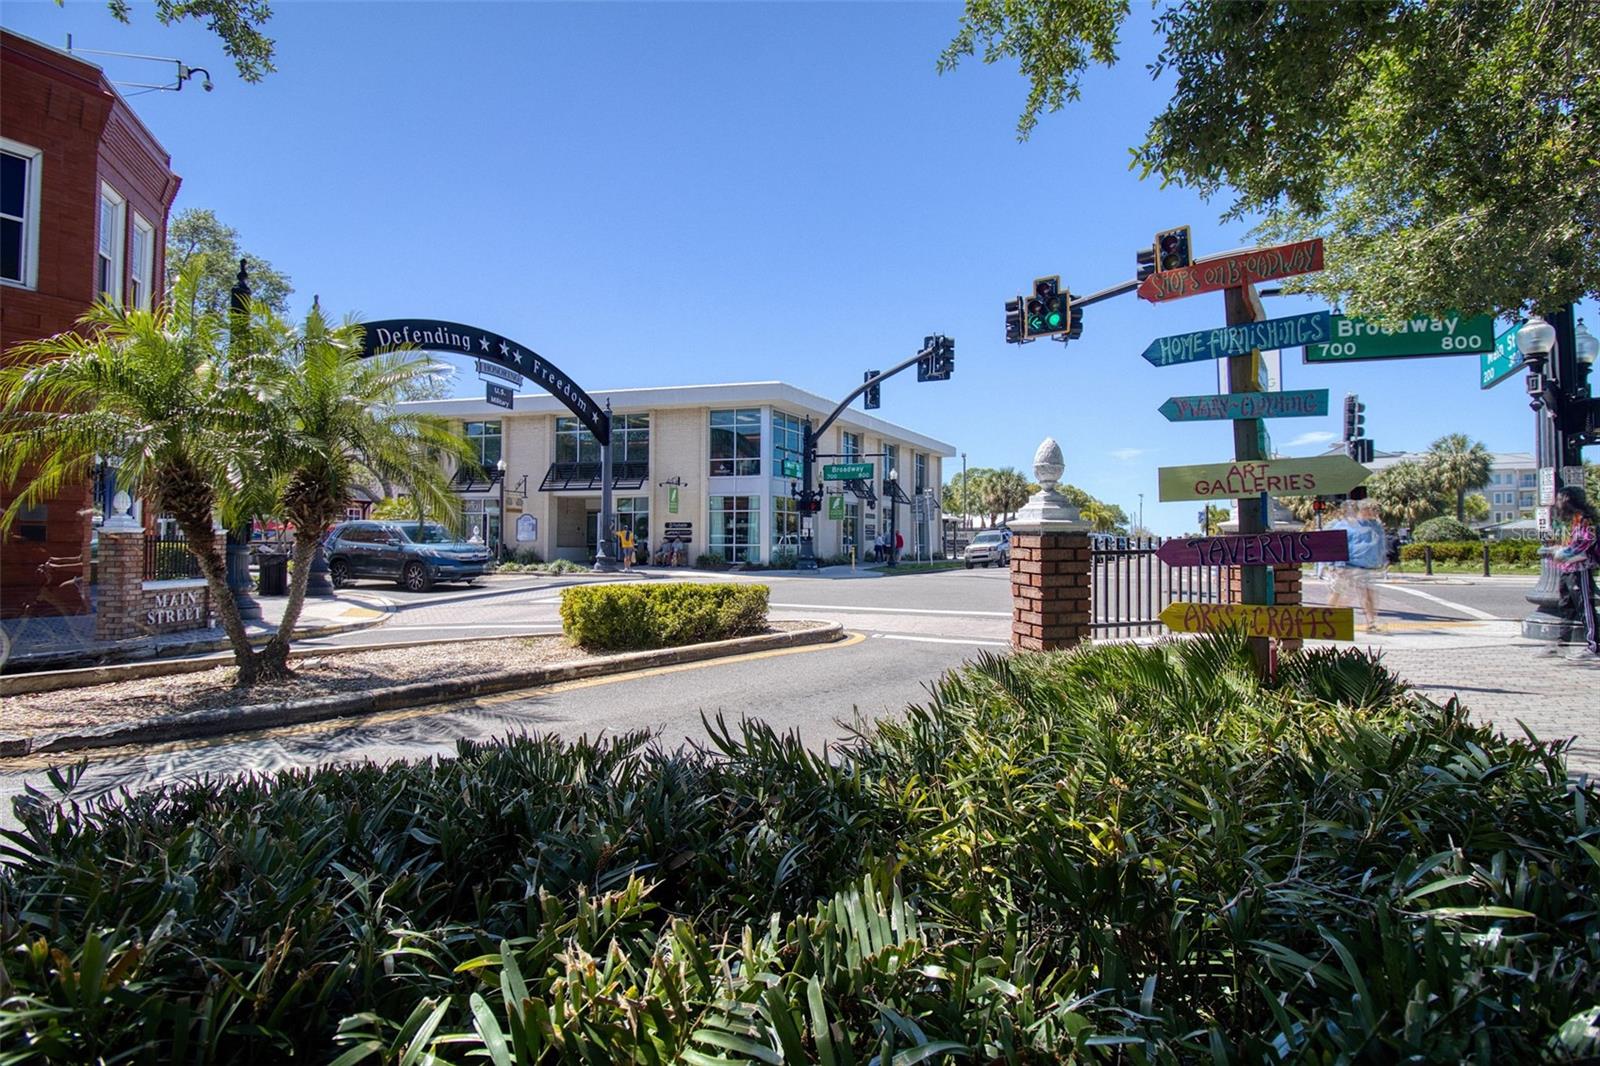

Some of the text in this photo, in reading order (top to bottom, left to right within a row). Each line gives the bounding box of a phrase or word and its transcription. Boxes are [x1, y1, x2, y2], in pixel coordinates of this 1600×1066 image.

[1158, 332, 1206, 365] HOME
[1318, 335, 1482, 357] 700 800
[376, 326, 588, 412] Defending Freedom
[494, 386, 507, 396] U.S.
[490, 395, 510, 408] Military
[1226, 463, 1270, 479] ART
[1194, 473, 1317, 496] GALLERIES
[1185, 532, 1312, 566] TAVERNS
[155, 592, 197, 607] MAIN
[147, 607, 202, 624] STREET
